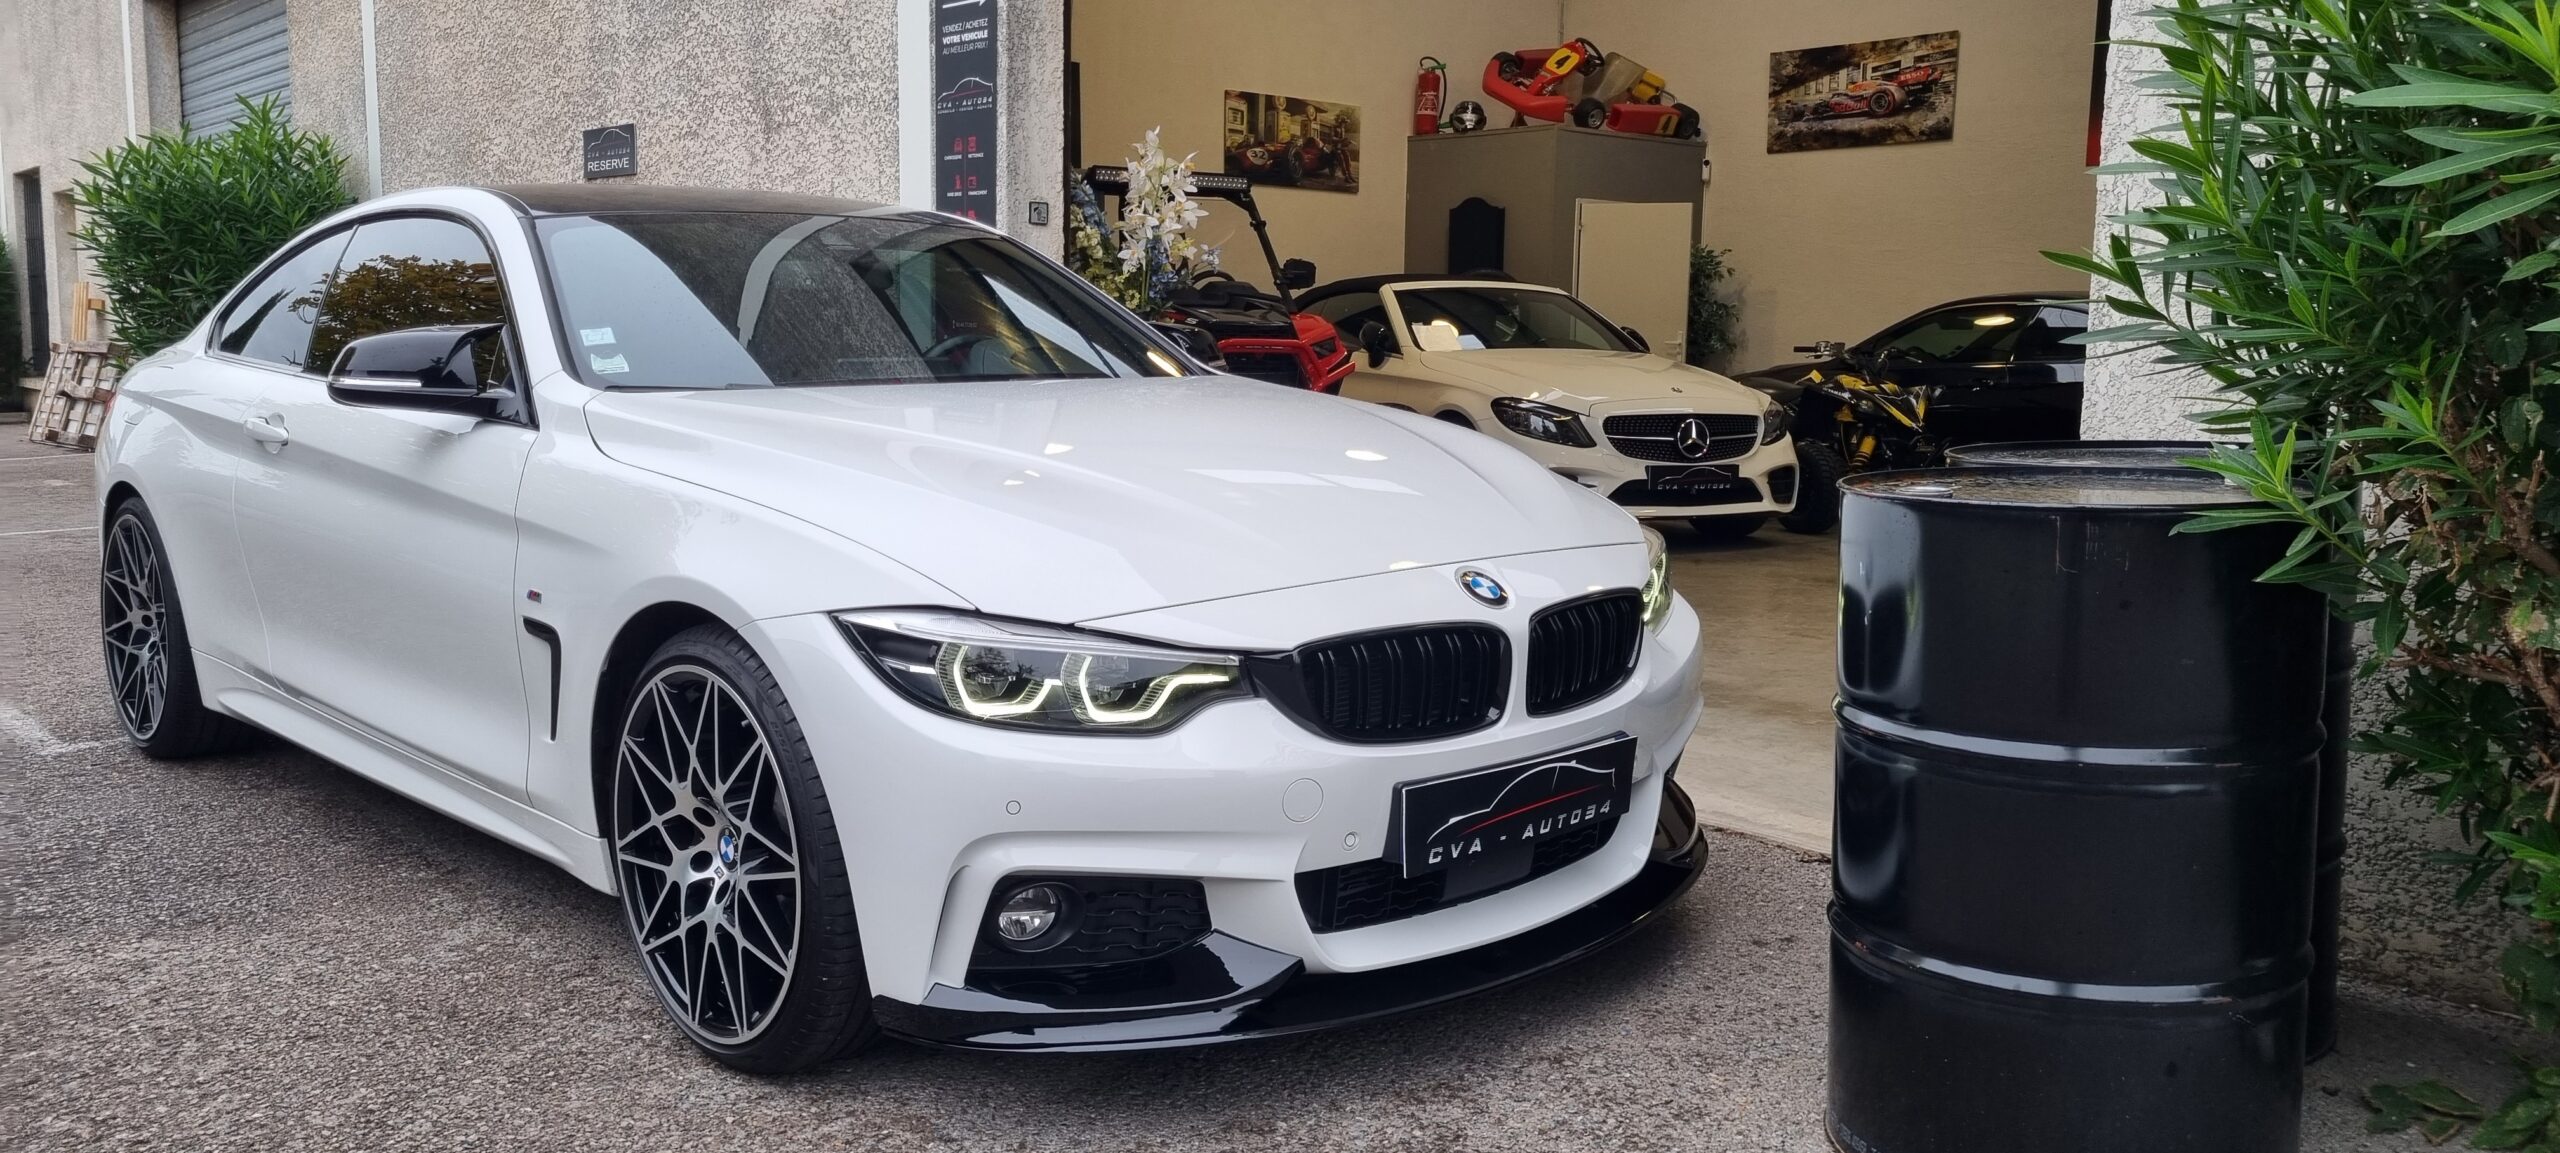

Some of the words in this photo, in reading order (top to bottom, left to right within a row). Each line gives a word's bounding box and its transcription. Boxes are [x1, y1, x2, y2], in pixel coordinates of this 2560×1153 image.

[942, 34, 961, 45] VOTRE
[961, 30, 988, 41] VEHICULE
[942, 47, 950, 55] AU
[950, 43, 974, 54] MEILLEUR
[1555, 55, 1571, 69] 4
[1250, 150, 1267, 160] 32
[587, 158, 629, 171] RESERVE
[1428, 837, 1482, 864] CVA
[1522, 799, 1611, 840] AUTO34
